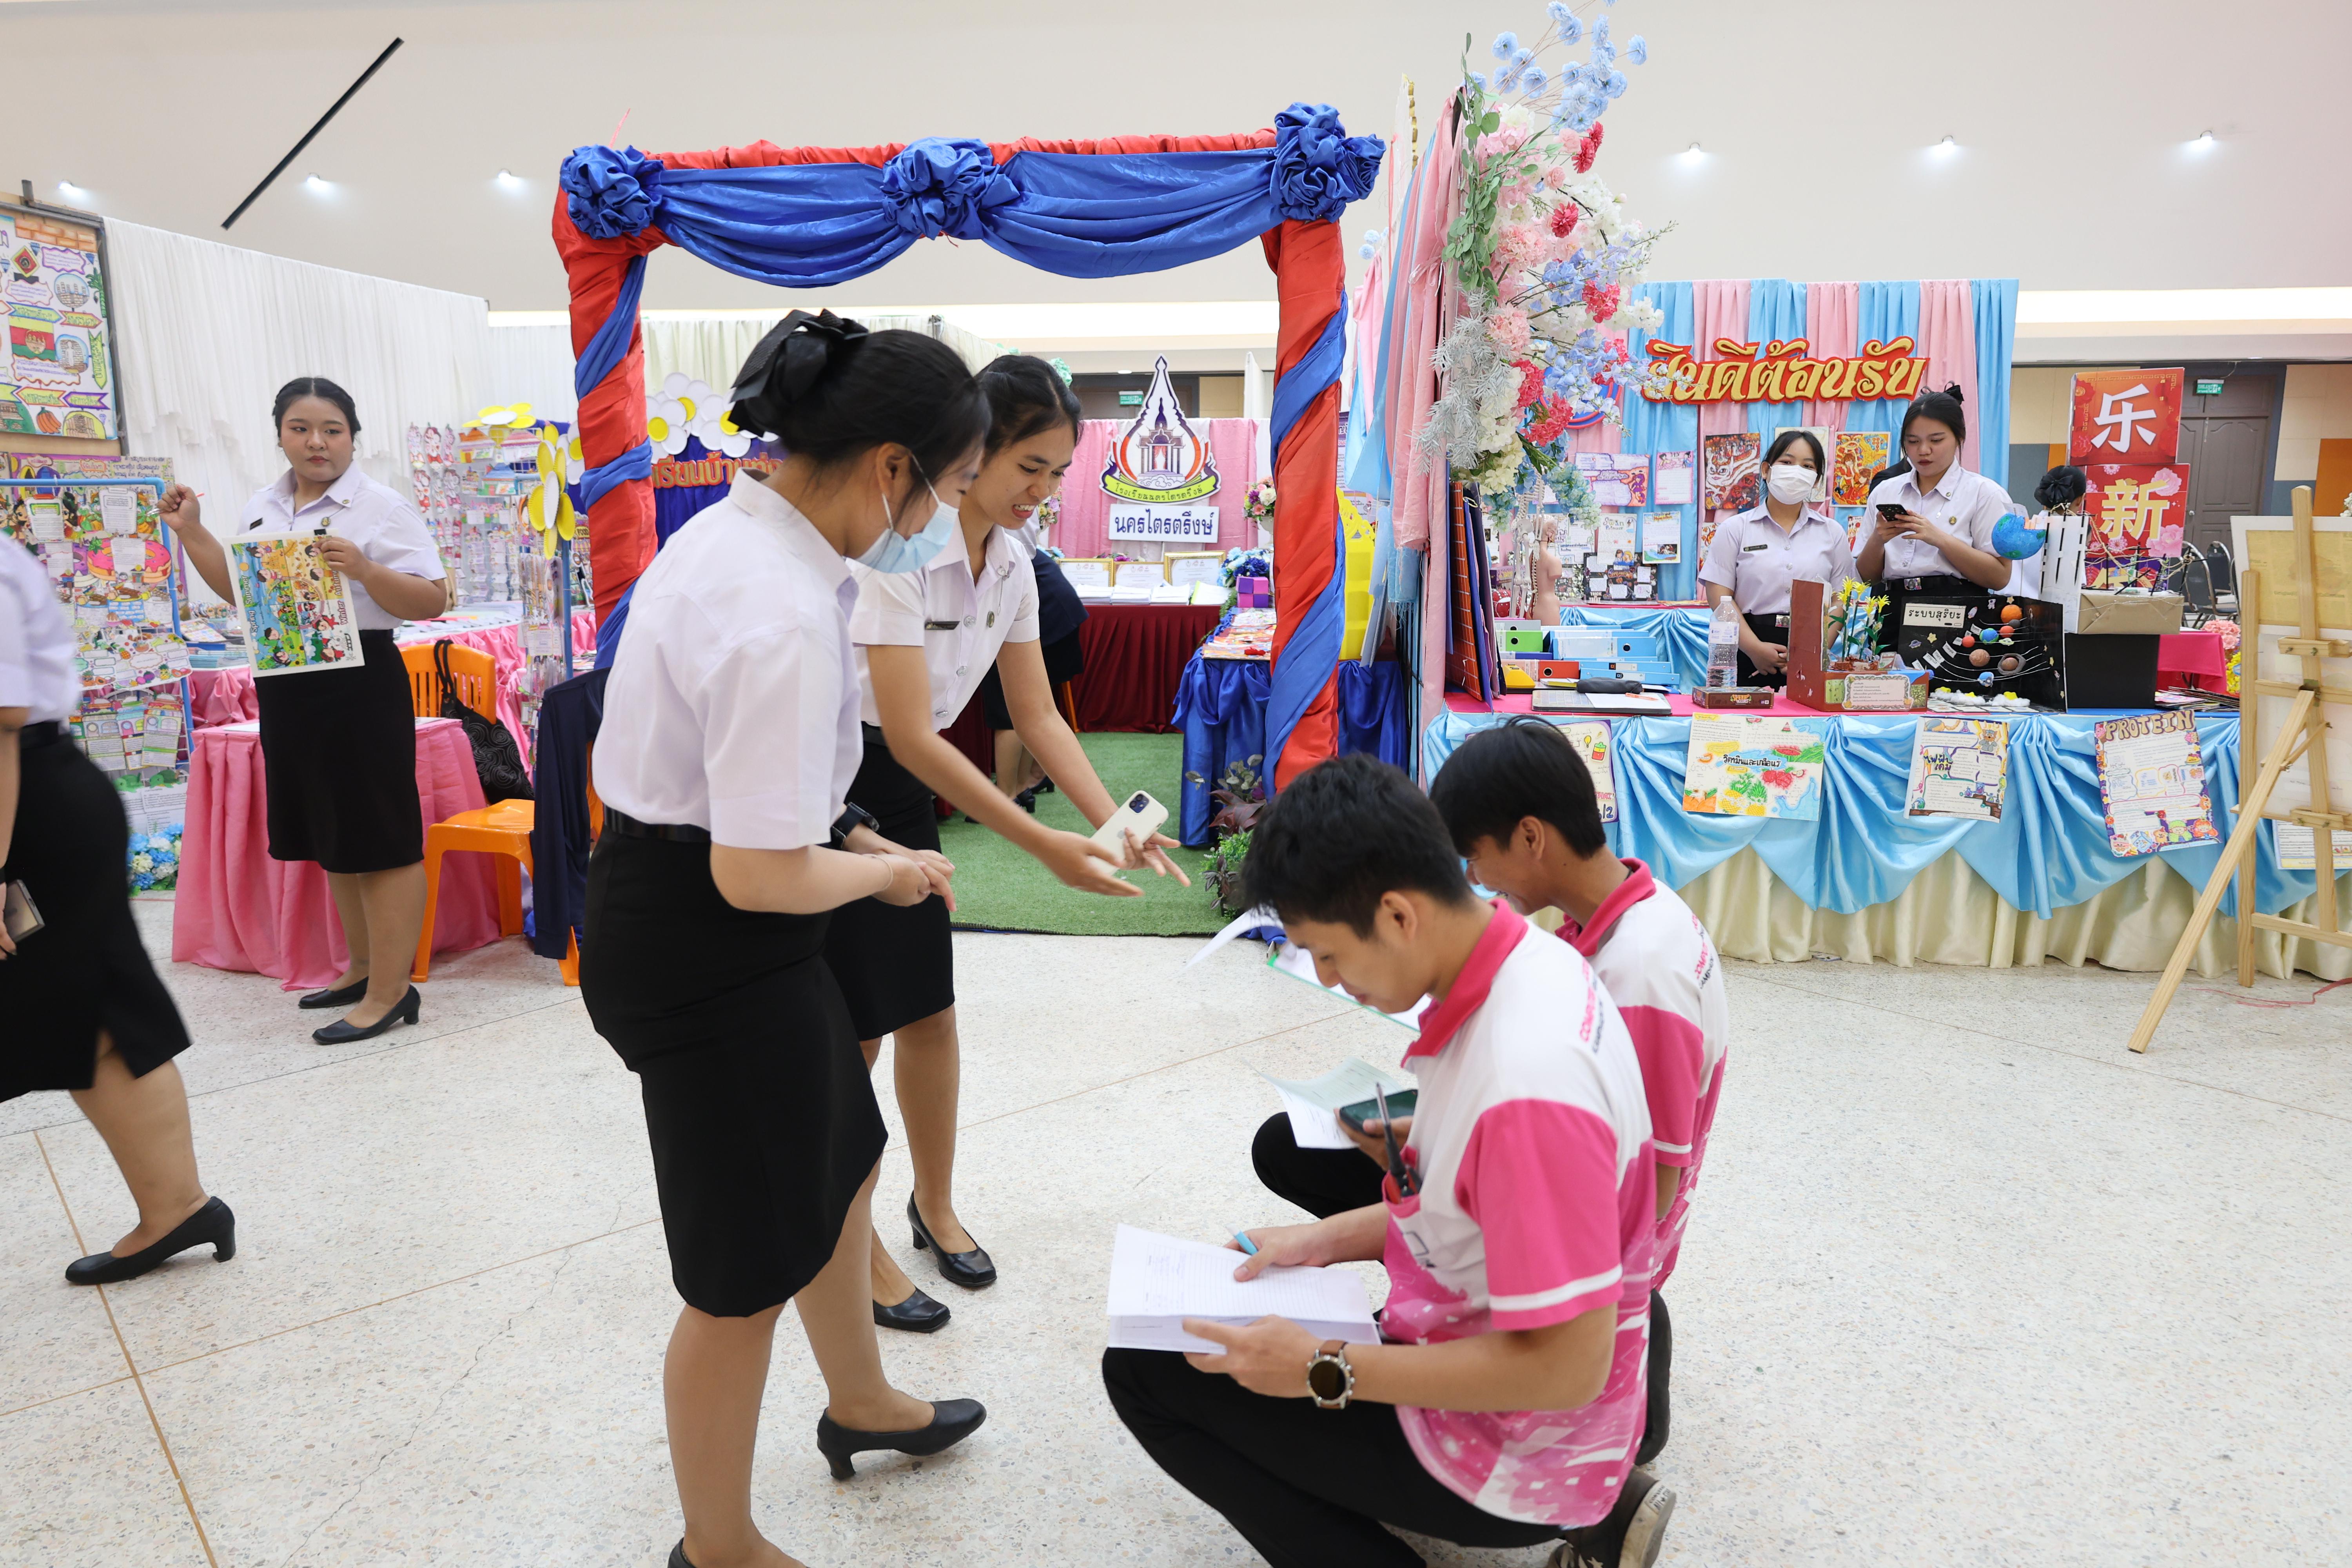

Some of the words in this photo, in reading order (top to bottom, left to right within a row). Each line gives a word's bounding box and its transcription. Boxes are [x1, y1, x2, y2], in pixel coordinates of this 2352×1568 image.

[1644, 338, 1923, 401] ยินดีต้อนรับ
[2091, 383, 2157, 453] 乐
[1115, 483, 1203, 501] โรงเรียนนครไตรตรึงษ์
[1114, 508, 1214, 536] นครไตรตรึงษ์
[1603, 517, 1624, 526] Swan
[2099, 478, 2171, 541] 新
[244, 575, 253, 604] Summer
[1909, 608, 1961, 621] ระบบสุริยะ
[2105, 710, 2194, 741] PROTEIN
[1723, 754, 1781, 767] วิตามินและเกลือแร่
[1923, 753, 1951, 765] ไฟฟ้า
